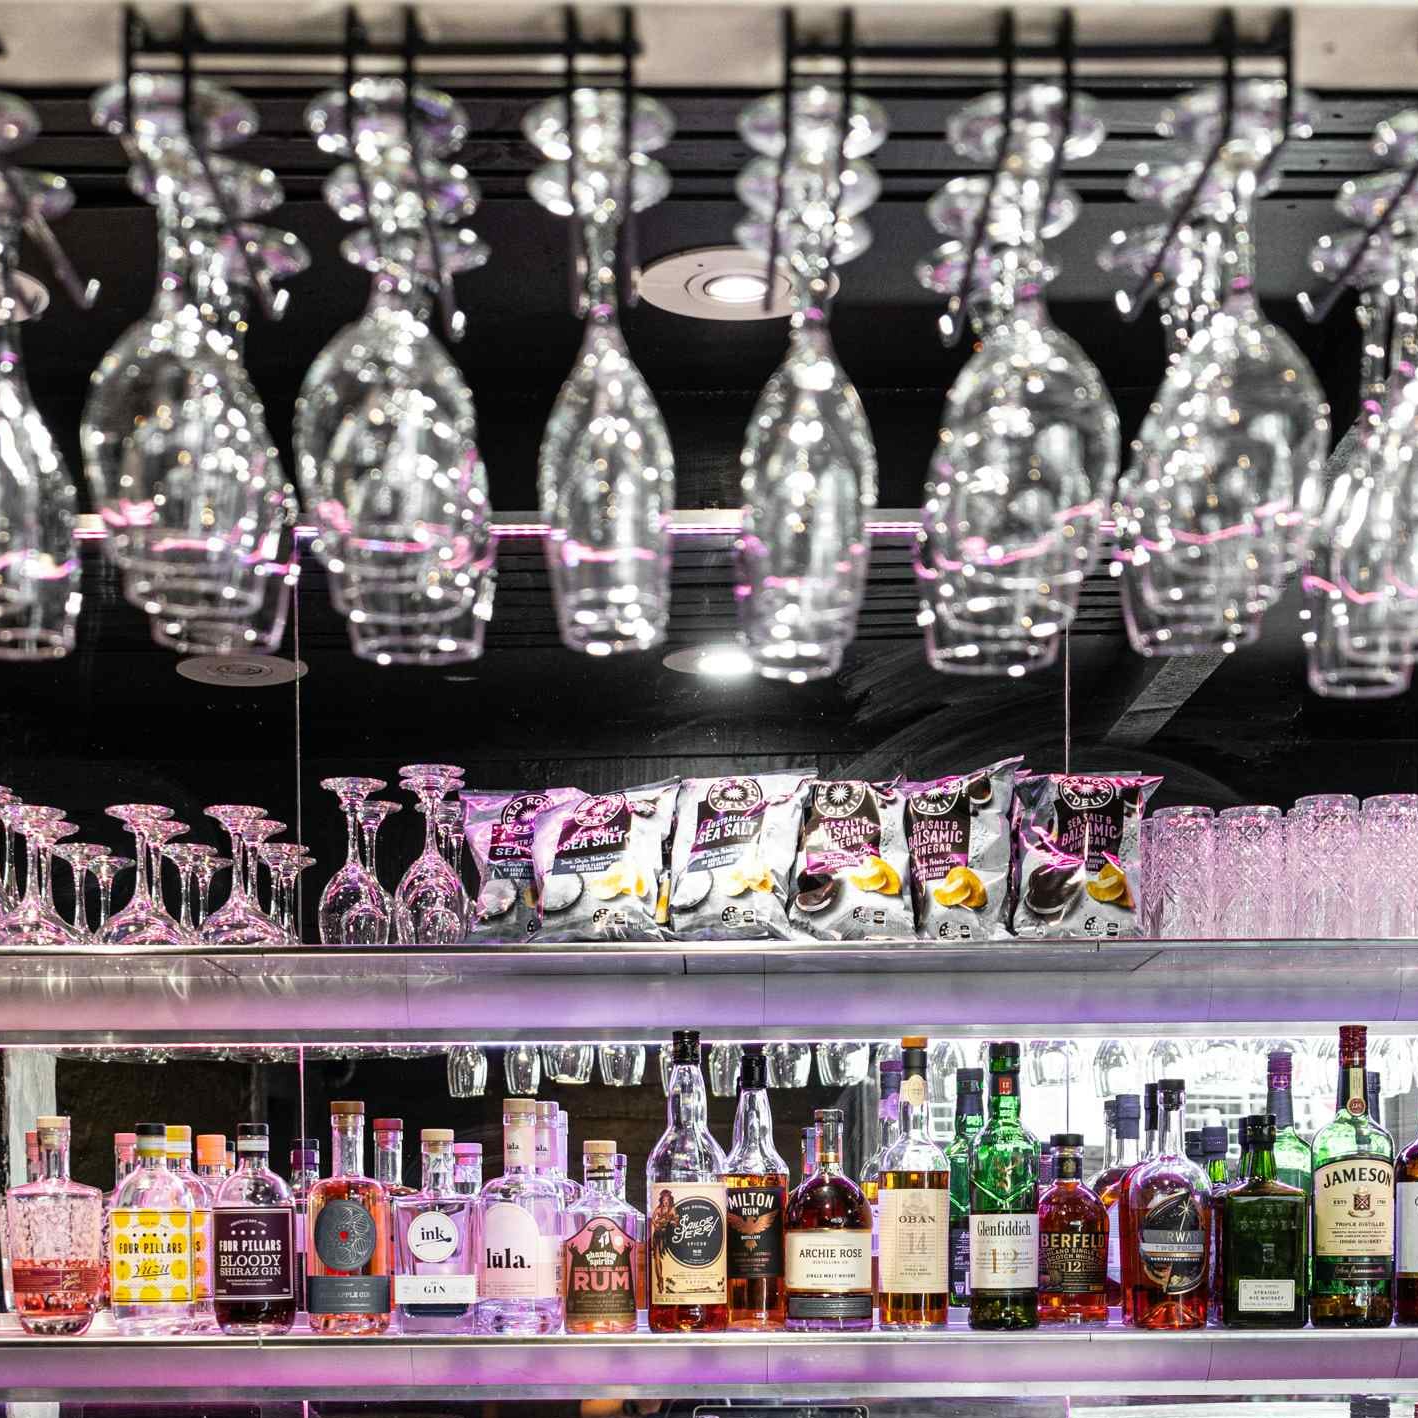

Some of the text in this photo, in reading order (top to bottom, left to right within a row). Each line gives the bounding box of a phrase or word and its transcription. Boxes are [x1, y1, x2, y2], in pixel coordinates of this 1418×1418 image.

[817, 784, 827, 804] RE
[826, 800, 858, 816] DELI
[917, 800, 949, 813] DELI
[1072, 797, 1103, 807] DELI
[912, 821, 924, 834] SEA
[928, 820, 950, 830] SALT
[1068, 815, 1081, 830] SEA
[698, 822, 757, 845] SEA SALT
[908, 830, 963, 850] BALSAMIC
[1062, 822, 1117, 847] BALSAMIC
[563, 831, 625, 851] SEA SALT
[1070, 837, 1107, 852] VINGAR
[495, 847, 521, 856] SEA
[915, 843, 952, 857] VINEGAR
[1323, 1167, 1392, 1188] JAMESON
[727, 1192, 774, 1209] MILTON
[742, 1207, 760, 1216] RUM
[898, 1215, 935, 1224] OBAN
[421, 1227, 444, 1241] ink
[977, 1219, 1031, 1237] Glenfiddich
[119, 1242, 139, 1254] FOUR
[143, 1242, 182, 1254] PILLARS
[219, 1239, 281, 1252] FOUR PILLARS
[906, 1232, 928, 1254] 14
[799, 1248, 863, 1258] ARCHIE ROSE
[220, 1254, 281, 1267] BLOODY
[1067, 1261, 1082, 1273] 12
[220, 1267, 281, 1276] SHIRAZ GIN
[574, 1271, 630, 1292] RUM
[424, 1286, 446, 1294] GIN
